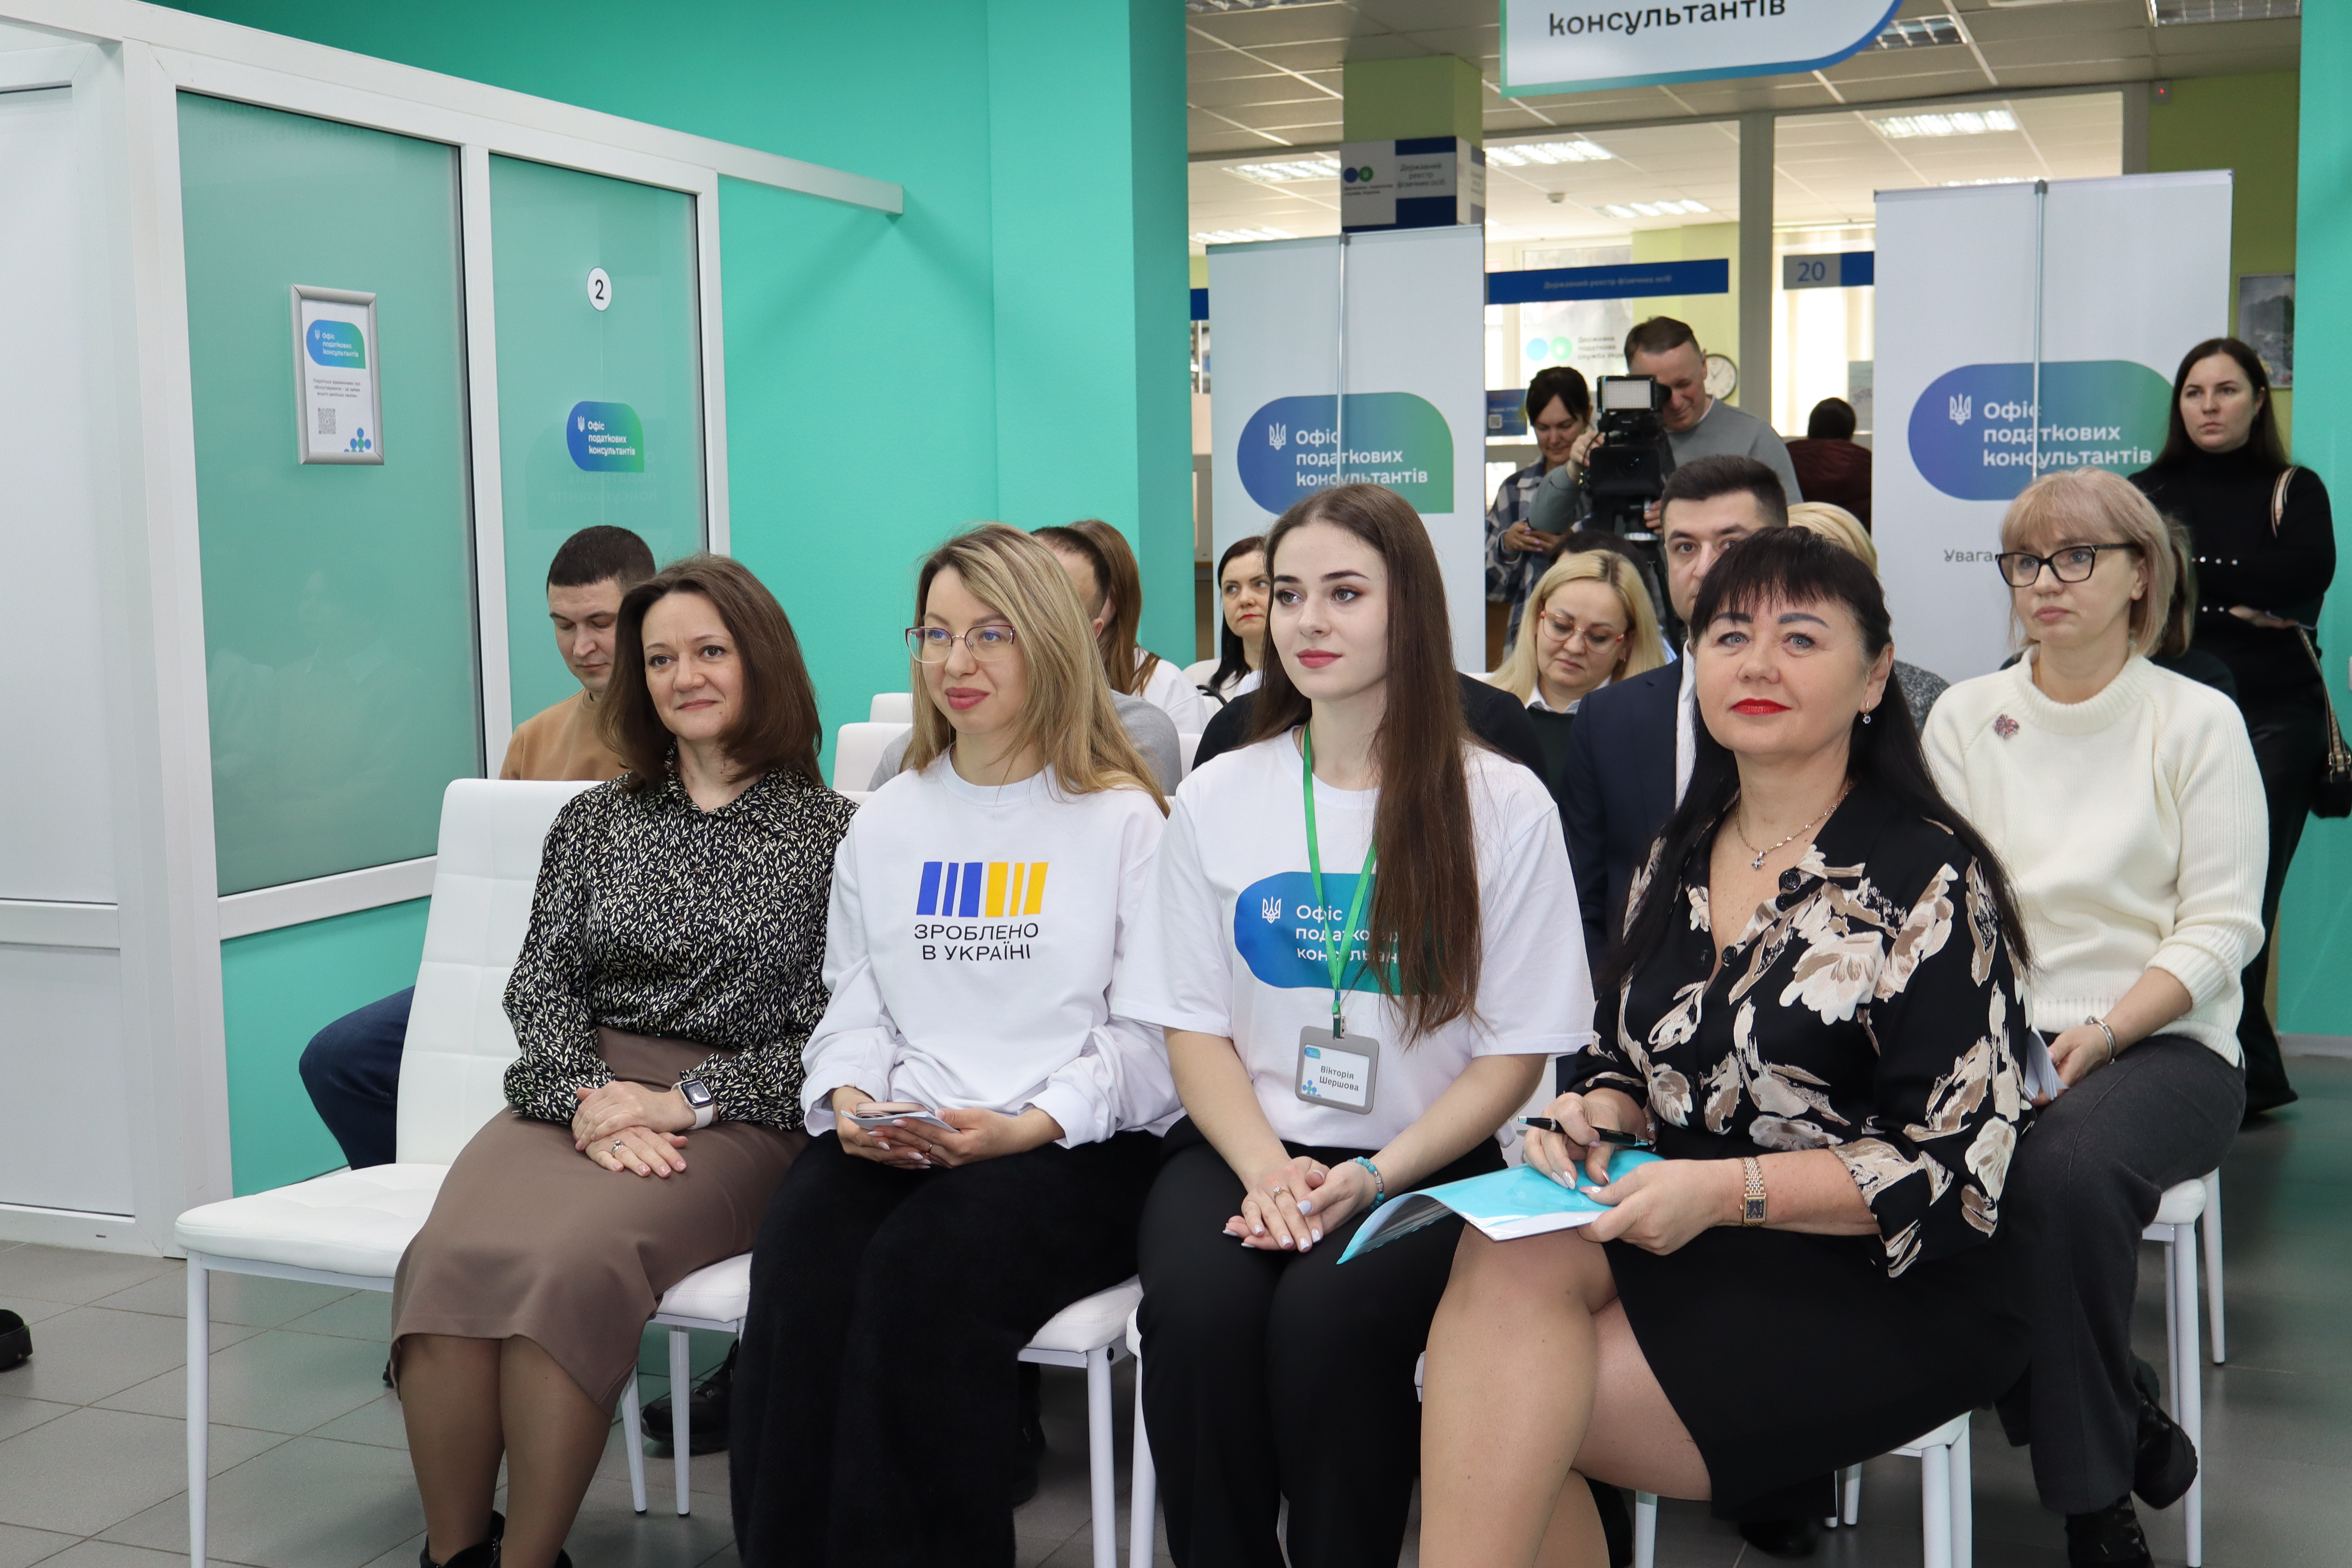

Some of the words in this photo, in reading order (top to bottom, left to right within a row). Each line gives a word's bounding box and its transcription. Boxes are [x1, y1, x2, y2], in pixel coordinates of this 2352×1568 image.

[1550, 0, 1785, 36] консультантів
[1797, 261, 1826, 282] 20
[595, 279, 604, 300] 2
[323, 348, 359, 358] консультантів
[1984, 401, 2042, 423] Офіс
[588, 421, 605, 432] Офіс
[1983, 424, 2121, 445] податкових
[588, 433, 627, 444] податкових
[1296, 429, 1338, 448] Офіс
[589, 445, 636, 457] консультантів
[1296, 449, 1403, 467] податкових
[1983, 446, 2152, 469] консультантів
[1944, 549, 1993, 562] Увага
[1296, 905, 1343, 924] Офіс
[914, 923, 1038, 940] ЗРОБЛЕНО
[922, 945, 936, 960] В
[944, 941, 1031, 961] УКРАЇНІ
[1321, 1065, 1354, 1080] Вікторія
[1319, 1076, 1359, 1092] Шершова
